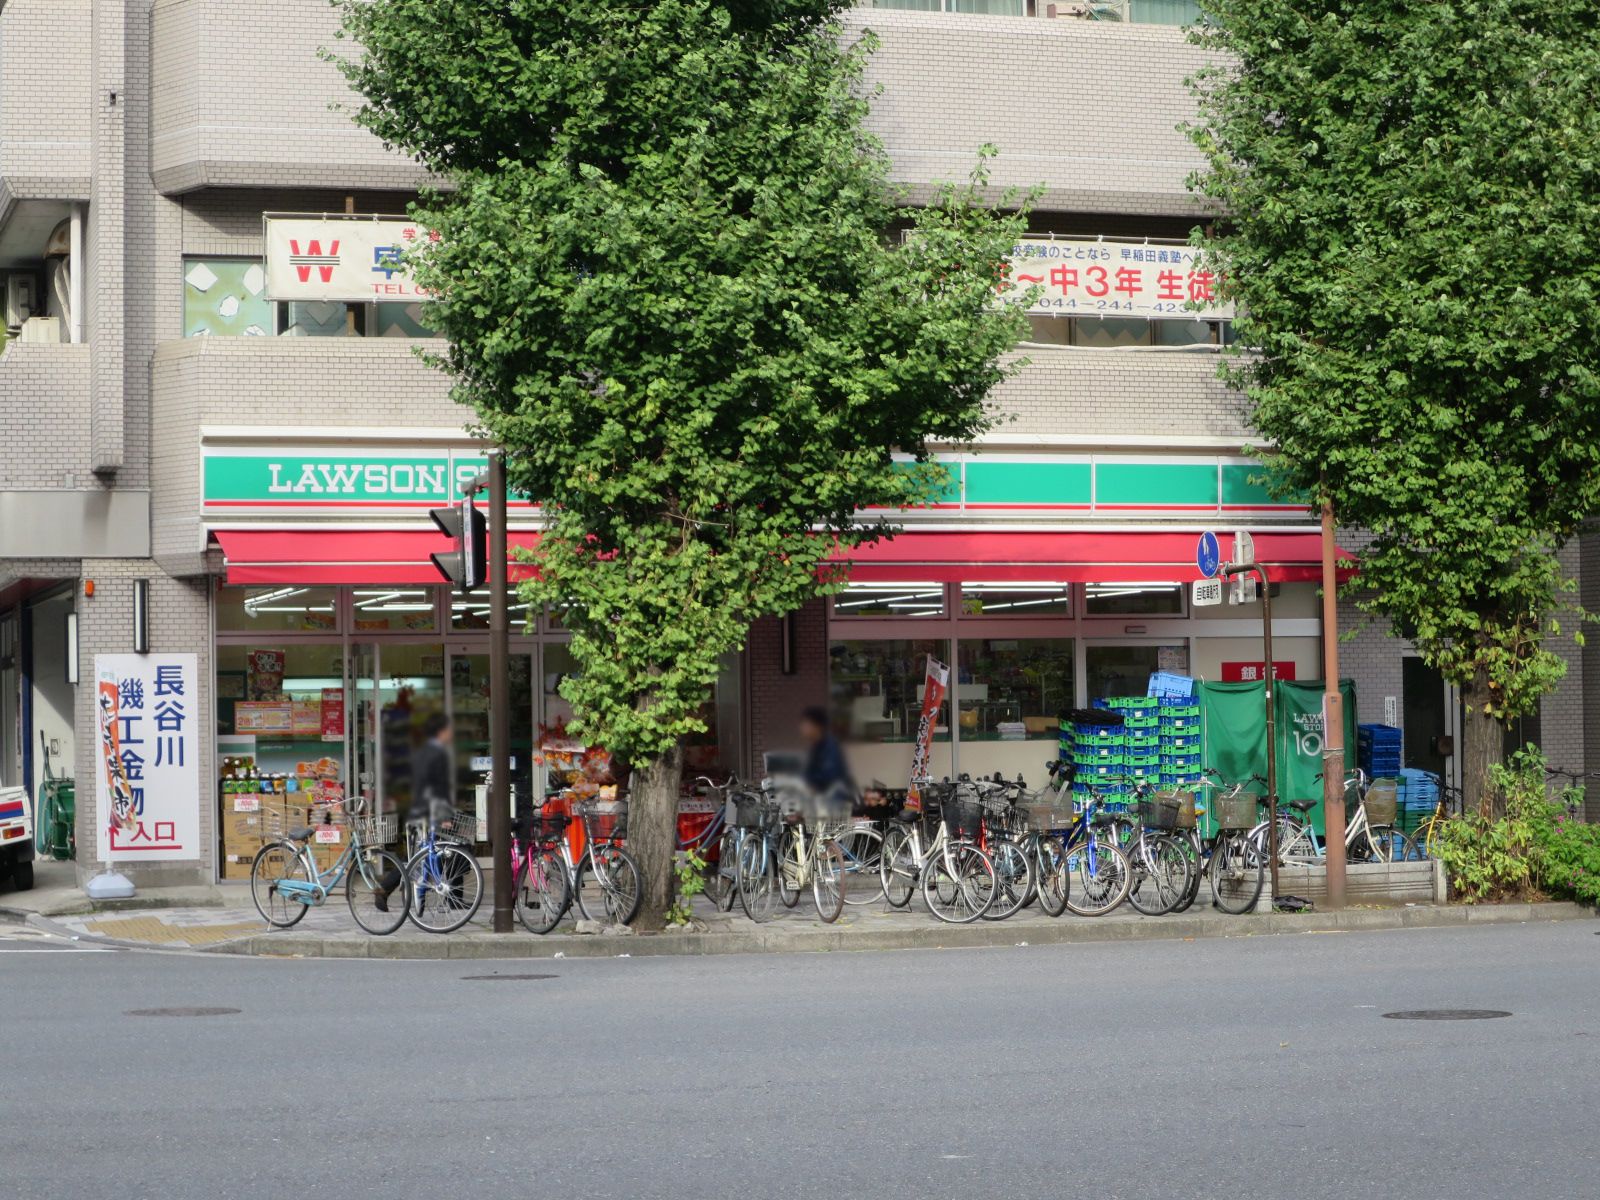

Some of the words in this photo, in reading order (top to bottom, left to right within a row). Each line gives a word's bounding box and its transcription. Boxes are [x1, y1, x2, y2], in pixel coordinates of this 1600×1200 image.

[371, 283, 410, 295] TEL
[268, 463, 446, 493] LAWSON
[153, 665, 186, 767] 長谷川
[130, 822, 175, 842] 入口
